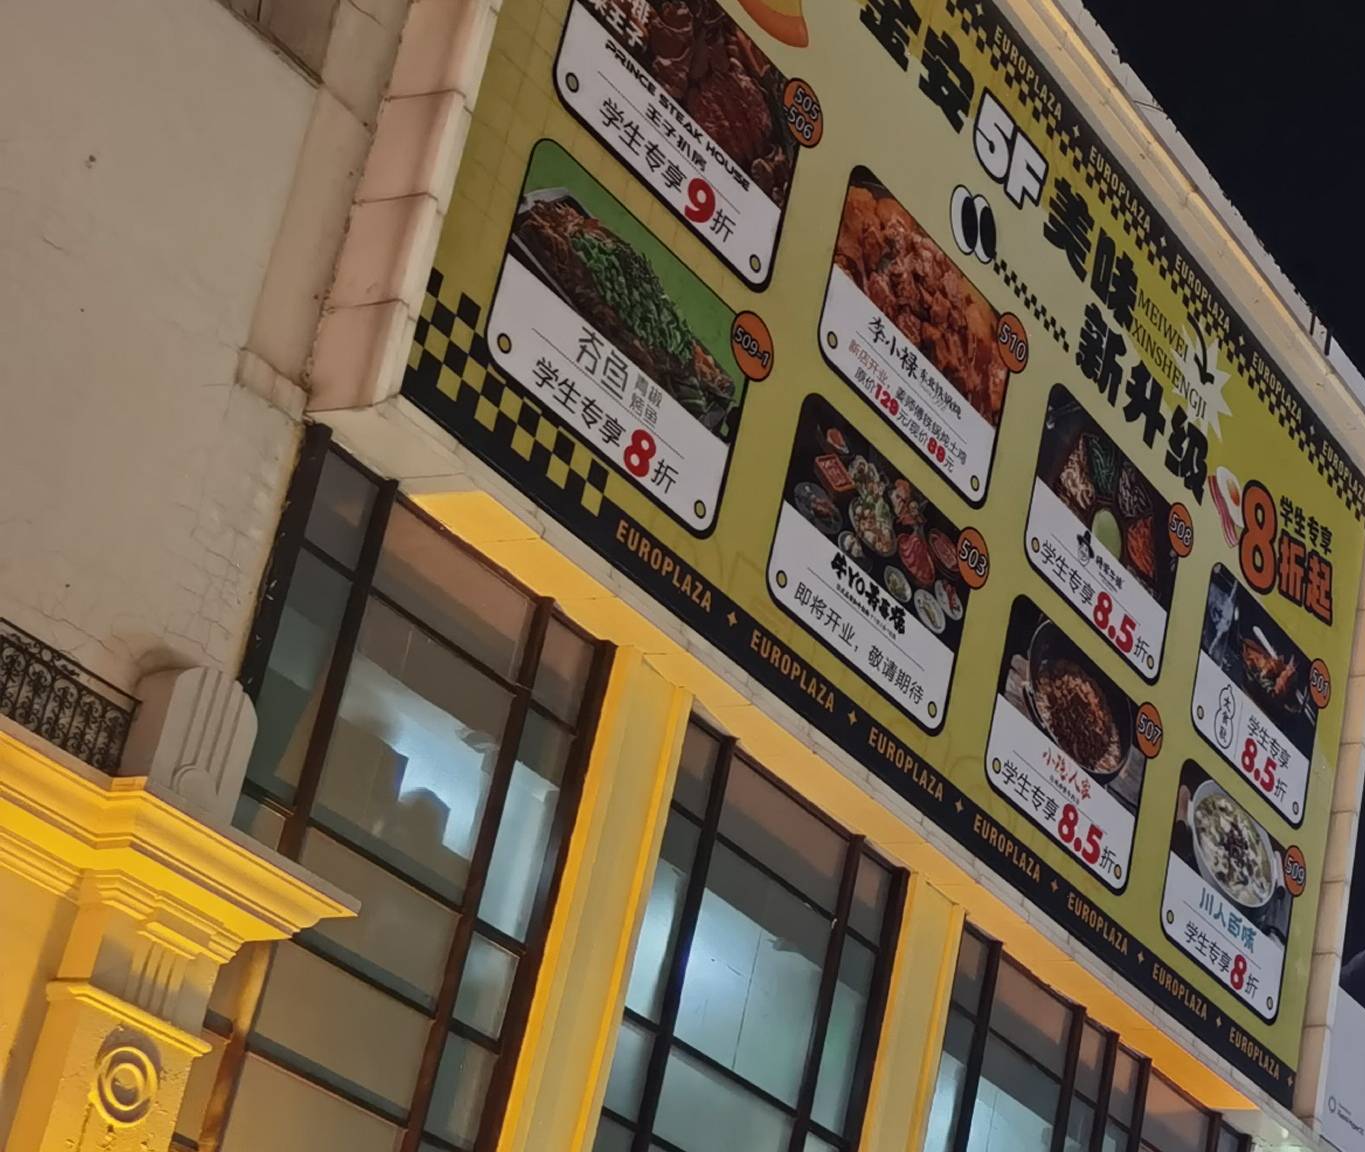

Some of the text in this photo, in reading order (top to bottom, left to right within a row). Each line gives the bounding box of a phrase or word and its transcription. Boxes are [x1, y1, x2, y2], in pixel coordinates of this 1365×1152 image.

[794, 86, 820, 120] 505
[994, 25, 1062, 121] EUROPLAZA
[605, 39, 750, 192] PRINCE STEAK HOUSE
[973, 86, 1049, 211] 5F
[1089, 144, 1151, 234] EUROPLAZA
[1043, 177, 1138, 333] 美味
[1137, 288, 1189, 364] MEIWEI
[1175, 253, 1230, 334] EUROPLAZA
[733, 326, 771, 368] 509-1
[999, 324, 1027, 362] 510
[1131, 317, 1207, 419] XINSHENGJI
[1075, 302, 1208, 506] 新升级
[1252, 353, 1302, 425] EUROPLAZA
[957, 538, 989, 581] 503
[1169, 512, 1193, 547] 508
[1279, 494, 1333, 555] 学生专享
[615, 519, 712, 613] EUROPLAZA
[749, 627, 836, 713] EUROPLAZA
[1311, 667, 1329, 698] 501
[1138, 713, 1163, 746] 507
[1247, 714, 1292, 769] 学生专享
[868, 727, 945, 803] EUROPLAZA
[974, 814, 1041, 884] EUROPLAZA
[1285, 857, 1305, 884] 509
[1067, 891, 1129, 955] EUROPLAZA
[1152, 962, 1208, 1020] EUROPLAZA
[1229, 1026, 1281, 1080] EUROPLAZA
